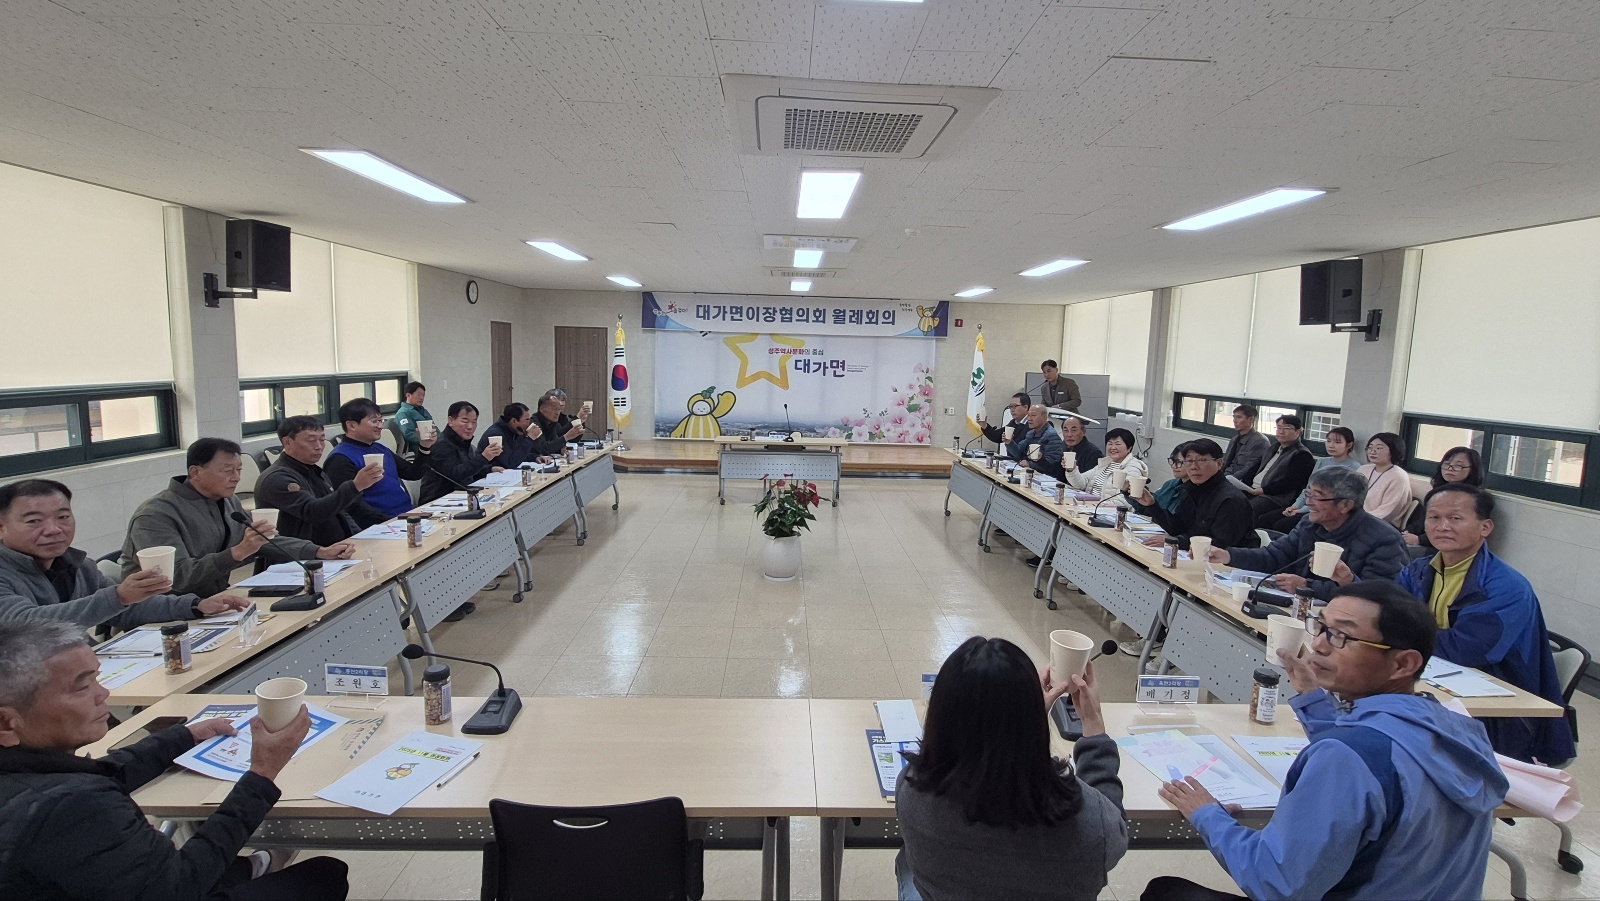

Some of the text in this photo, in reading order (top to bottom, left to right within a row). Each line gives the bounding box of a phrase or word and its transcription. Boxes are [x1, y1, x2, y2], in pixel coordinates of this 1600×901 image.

[696, 304, 827, 324] 대가면이장협의회
[832, 308, 896, 326] 월례회의
[768, 347, 824, 356] 성주역사문화의 중심
[794, 358, 846, 378] 대가면
